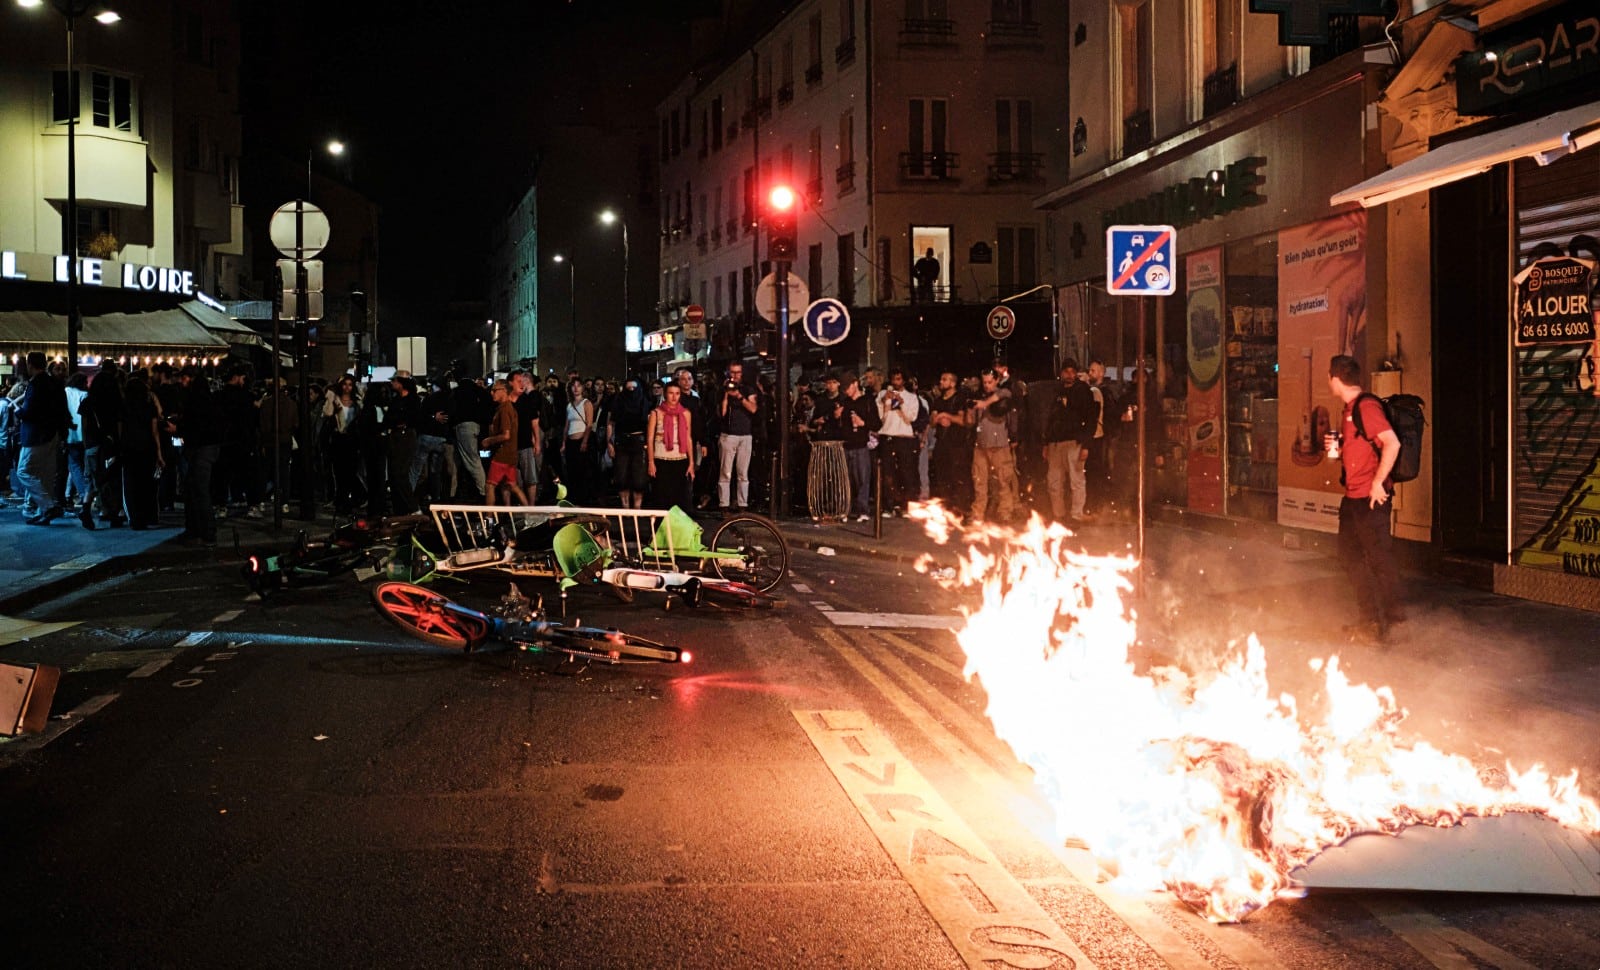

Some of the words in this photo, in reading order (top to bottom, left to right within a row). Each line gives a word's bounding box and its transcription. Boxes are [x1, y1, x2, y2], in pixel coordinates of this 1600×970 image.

[1285, 253, 1300, 264] Bien
[1302, 247, 1316, 261] plus
[1317, 242, 1338, 257] qu'un
[1339, 235, 1357, 250] goût
[1, 250, 27, 279] L
[123, 263, 194, 295] LOIRE
[1151, 272, 1164, 282] 20
[1545, 266, 1584, 277] BOSQUET
[1289, 299, 1324, 315] hydratation
[1537, 294, 1589, 316] LOUER
[992, 315, 1009, 330] 30
[1523, 325, 1535, 337] 06
[1536, 324, 1548, 336] 63
[1550, 323, 1562, 336] 65
[1565, 321, 1589, 335] 6000
